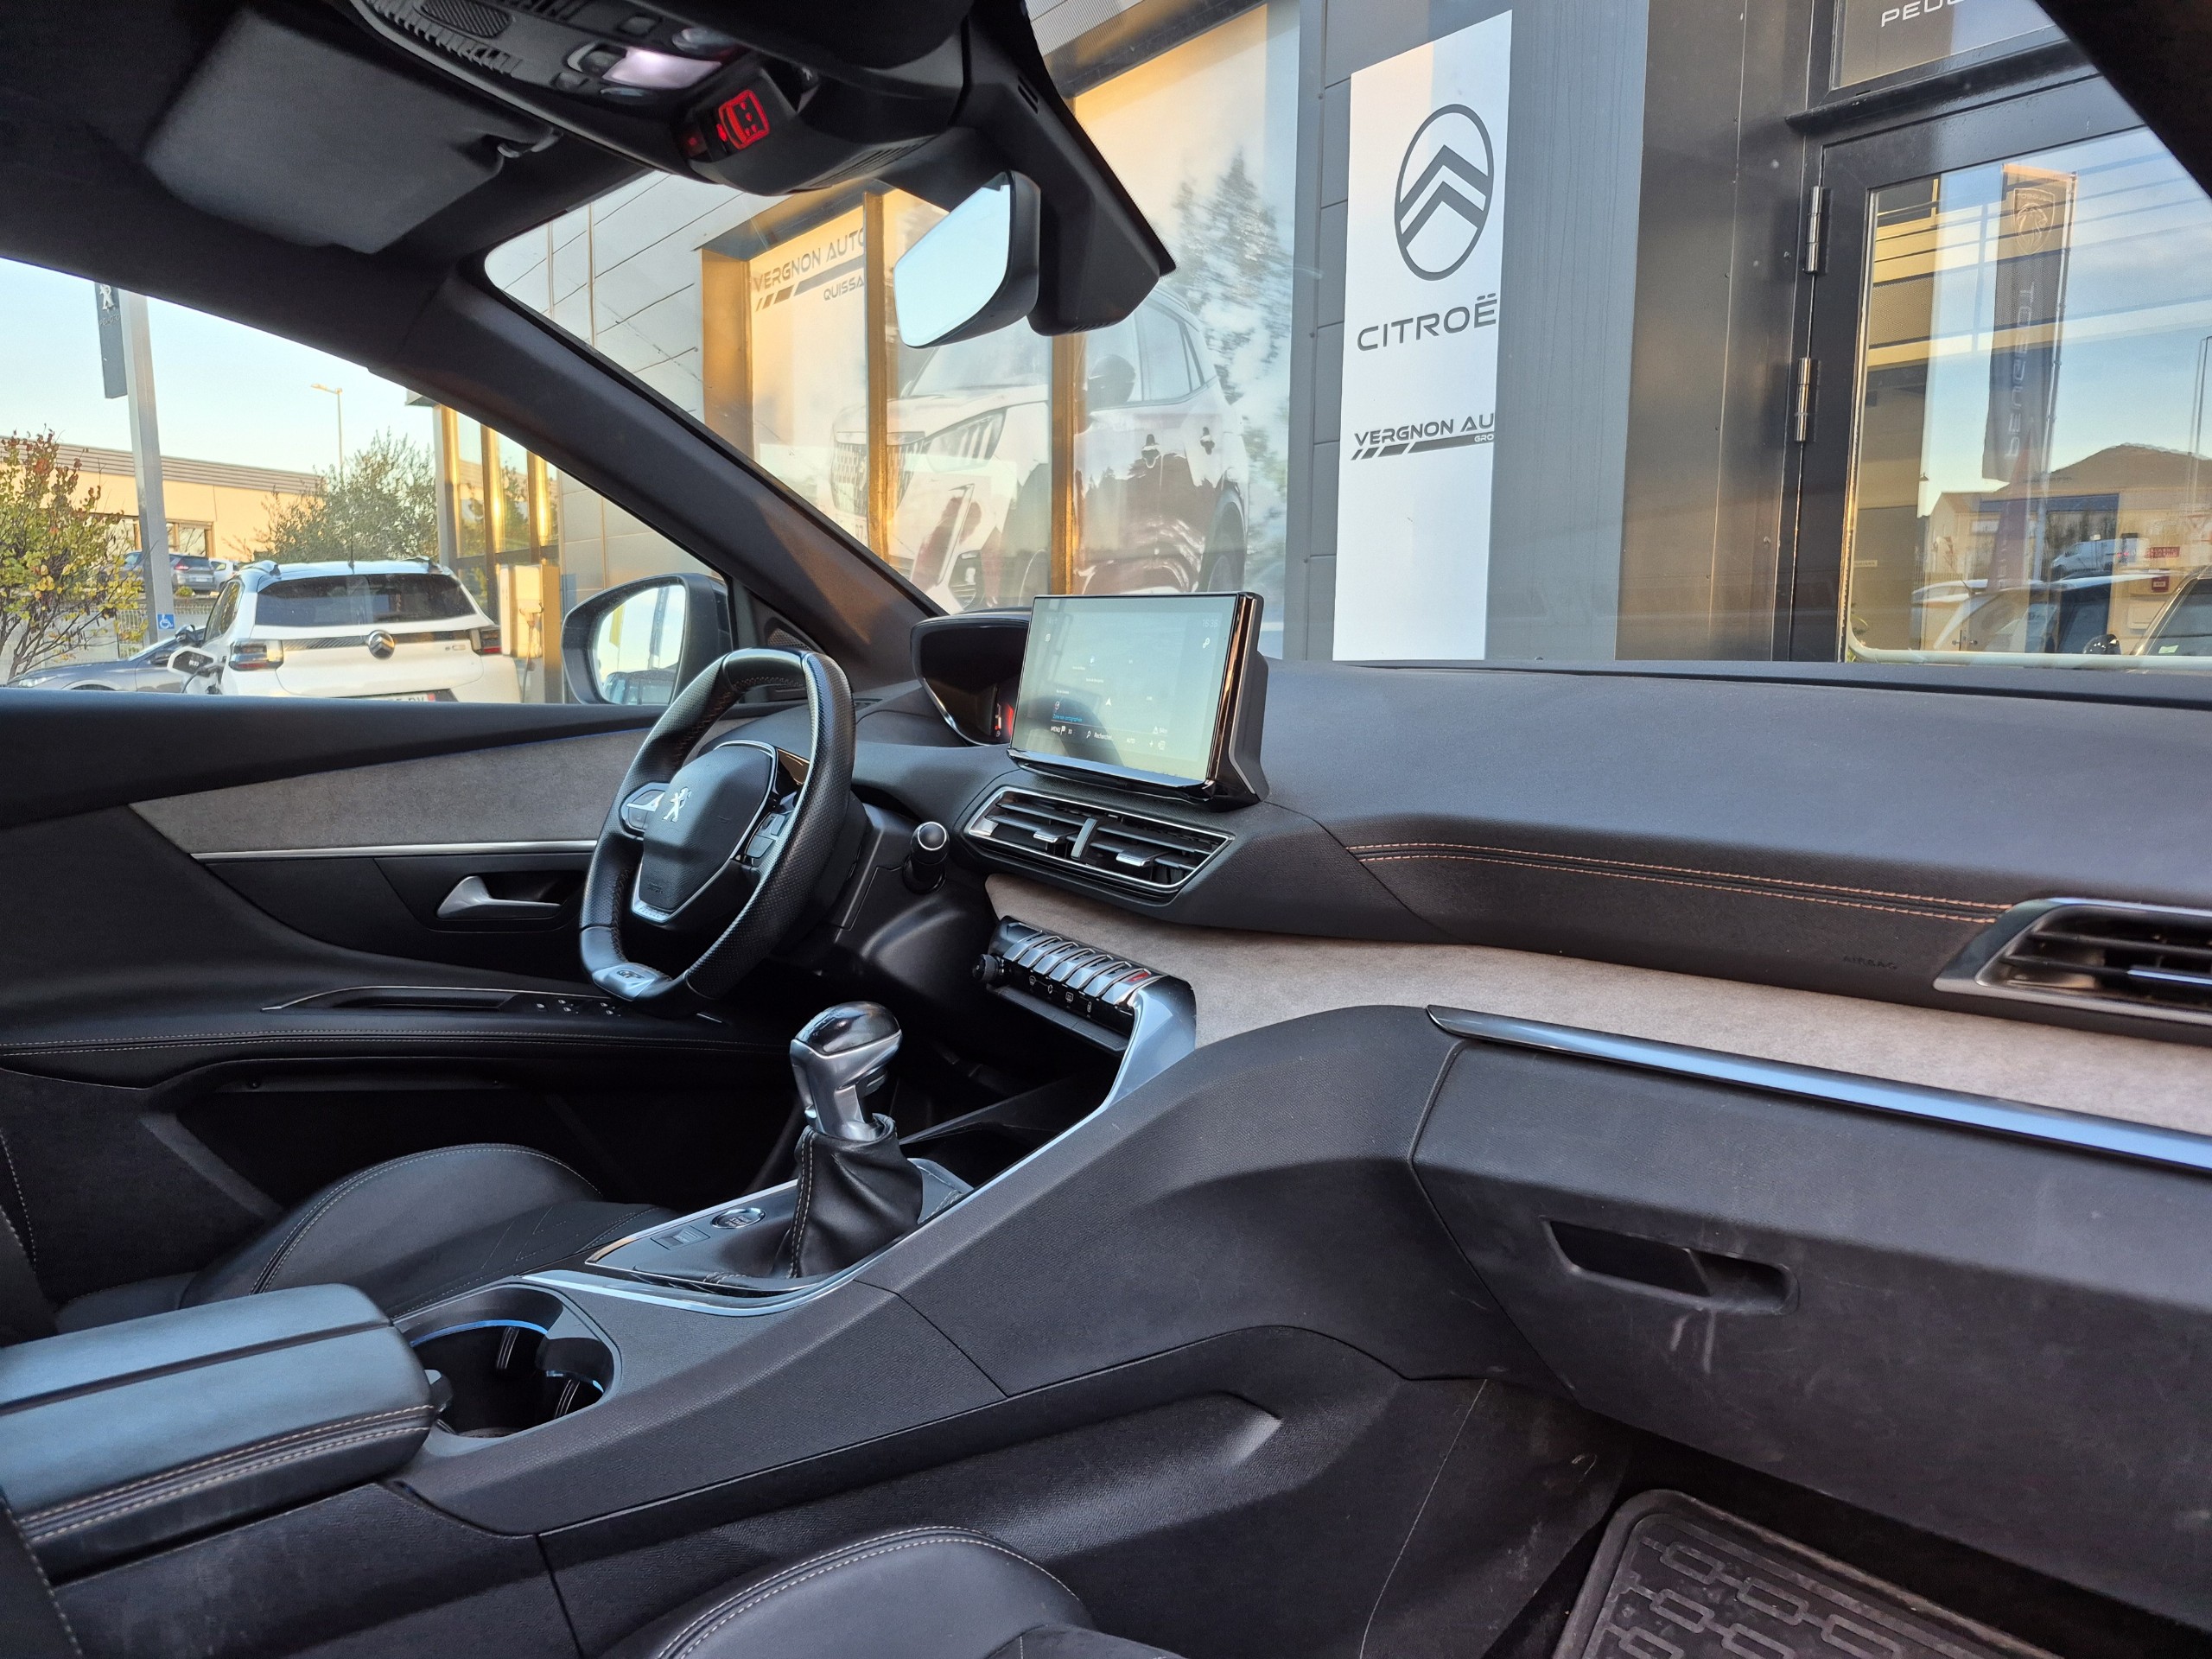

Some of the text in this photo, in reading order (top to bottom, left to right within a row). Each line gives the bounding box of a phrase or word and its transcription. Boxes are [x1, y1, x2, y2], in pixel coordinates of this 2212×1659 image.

[753, 247, 822, 293] VERGNON
[1357, 292, 1498, 352] CITROË
[1353, 412, 1495, 447] VERGNON AU
